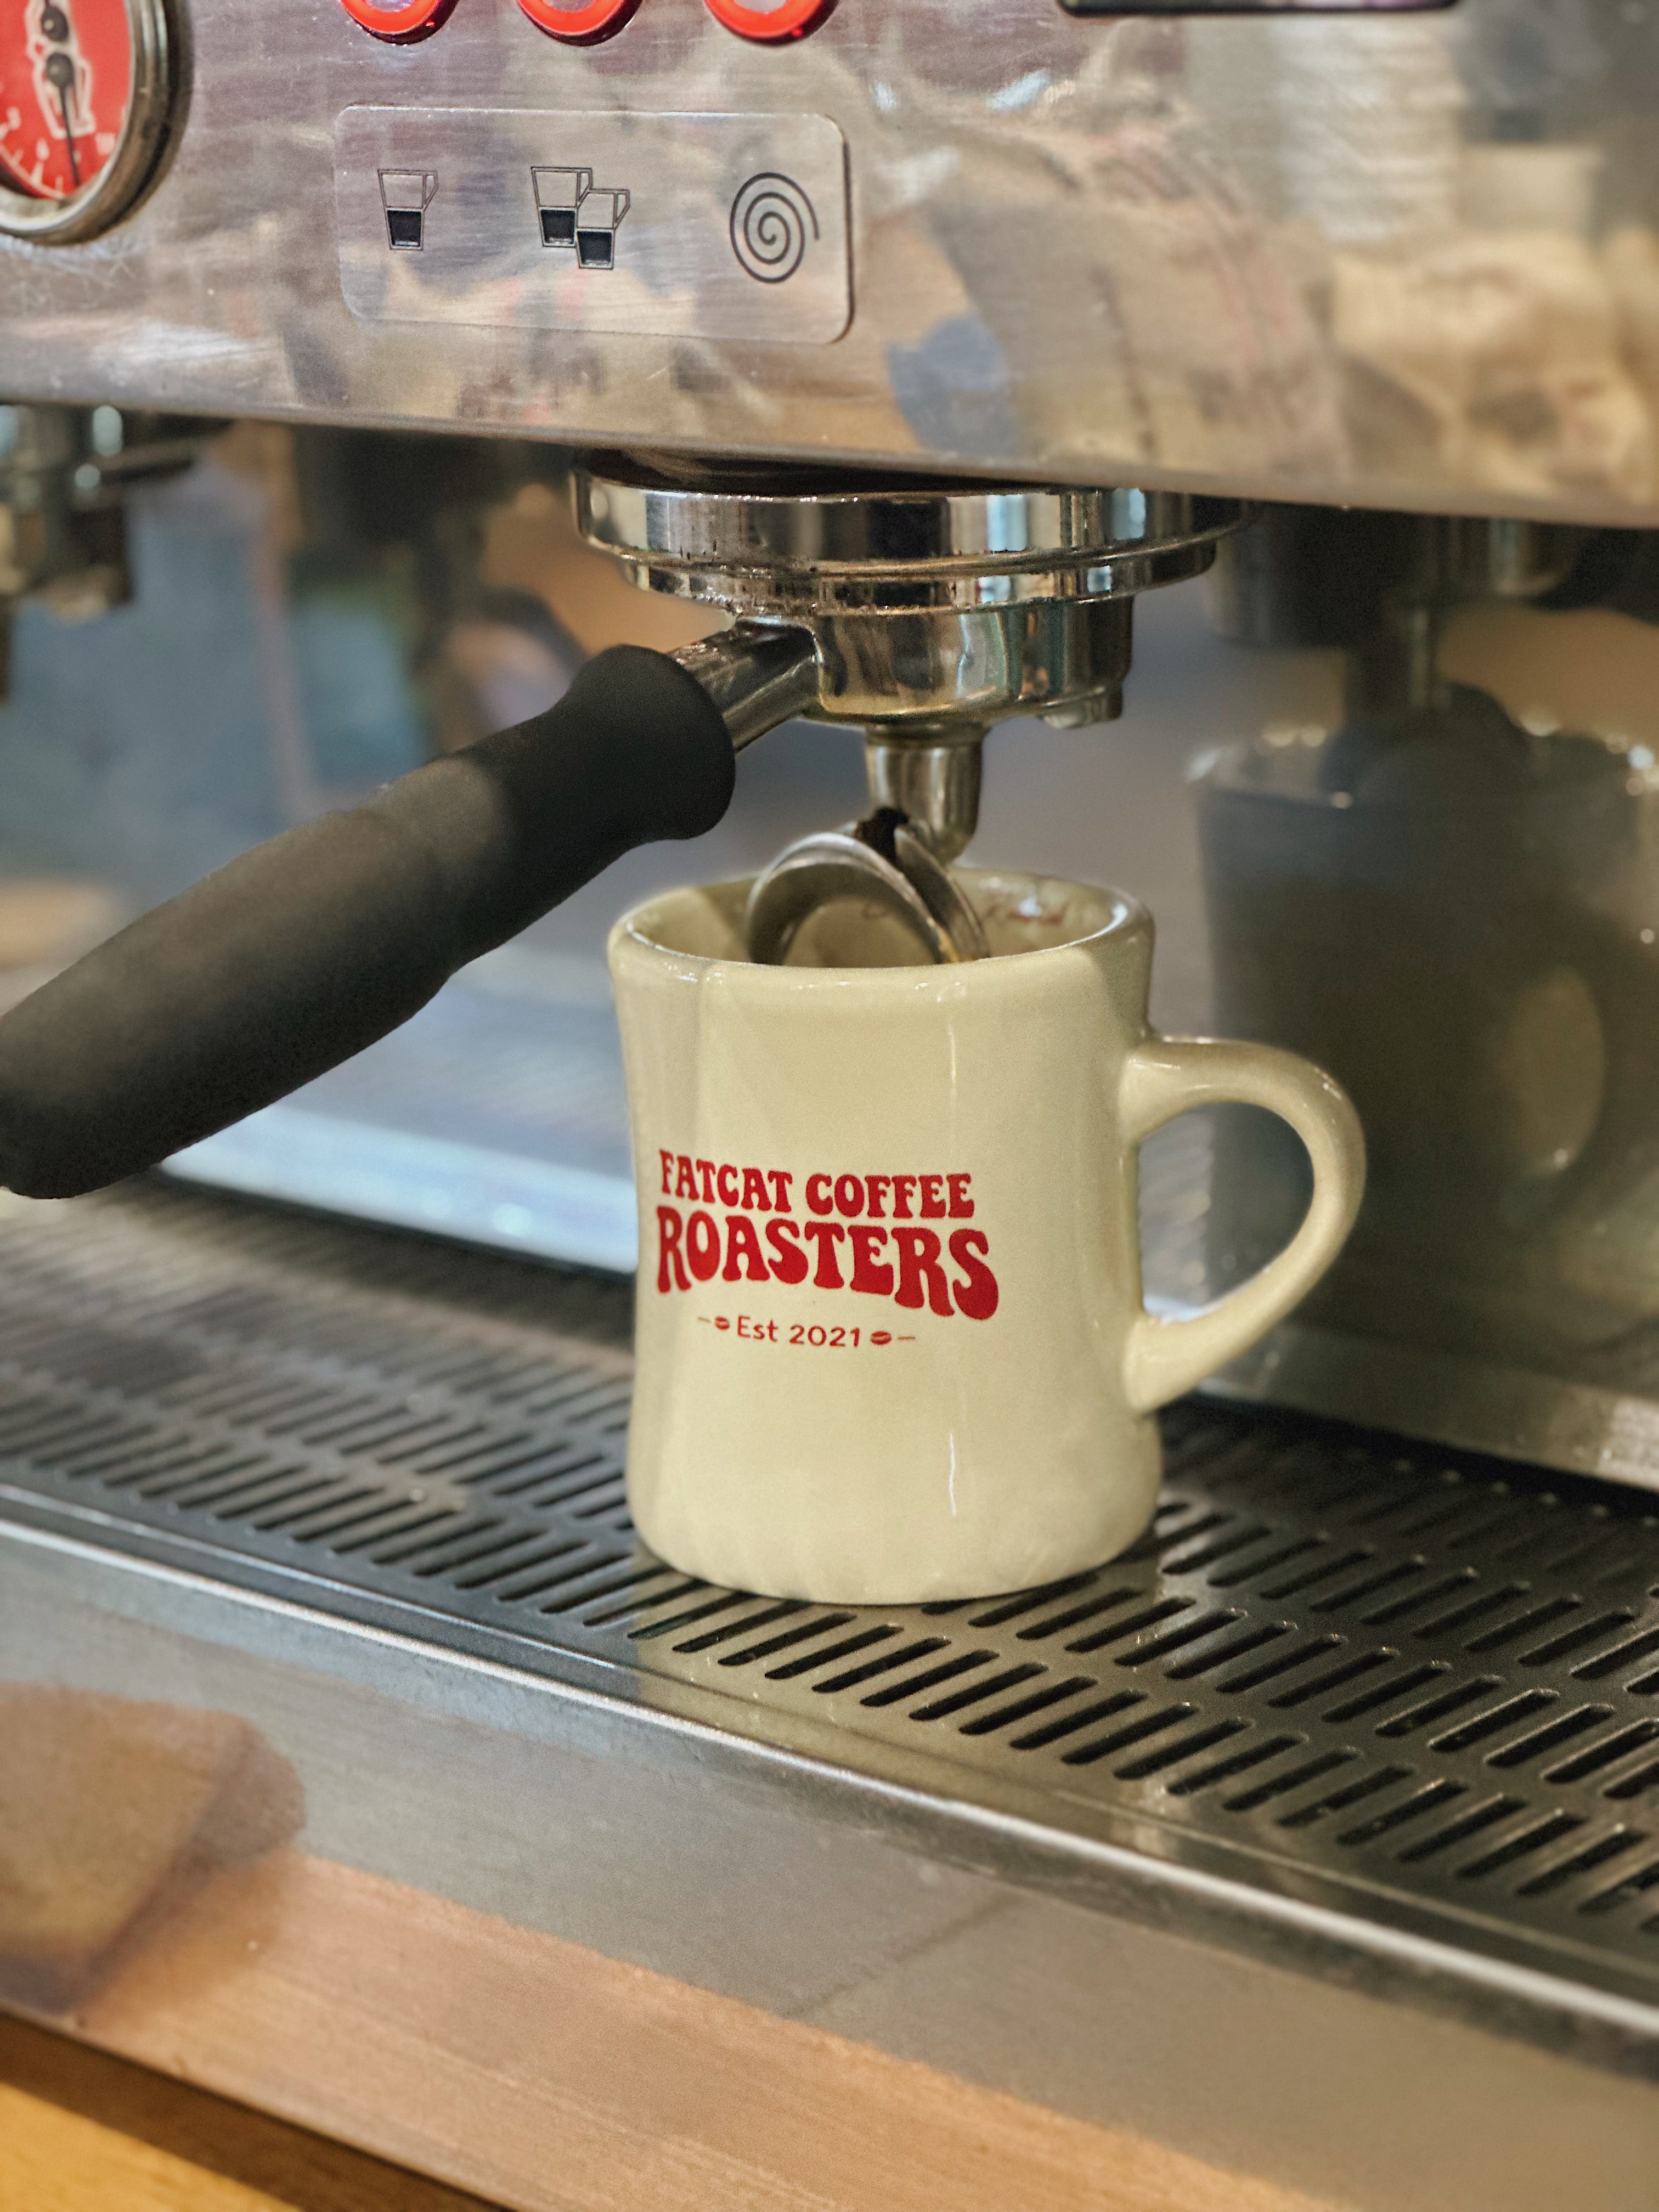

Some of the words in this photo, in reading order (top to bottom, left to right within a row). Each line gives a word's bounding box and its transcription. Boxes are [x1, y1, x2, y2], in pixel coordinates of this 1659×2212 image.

[659, 1149, 793, 1214] FATCAT
[804, 1172, 976, 1220] COFFEE
[656, 1204, 1000, 1321] ROASTERS
[736, 1314, 778, 1342] Est
[788, 1324, 861, 1348] 2021
